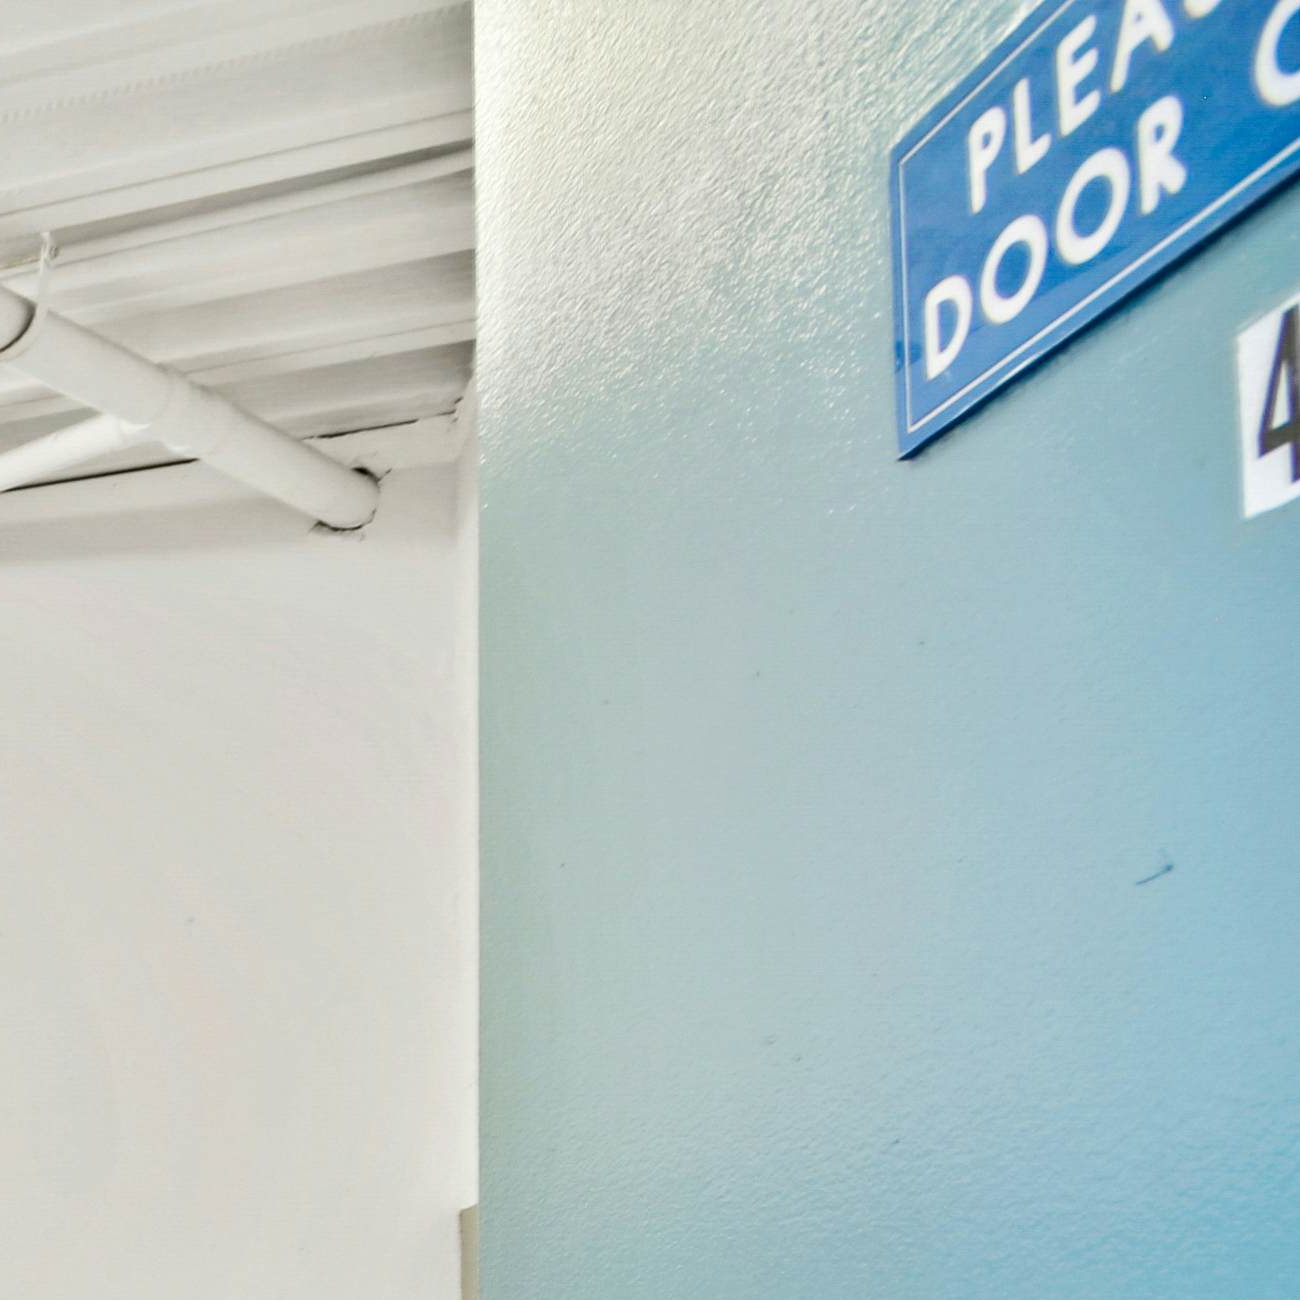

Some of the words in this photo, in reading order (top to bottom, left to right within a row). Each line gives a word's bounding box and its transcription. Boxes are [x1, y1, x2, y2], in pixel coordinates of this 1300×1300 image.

[966, 0, 1222, 215] PLEA
[923, 96, 1188, 381] DOOR
[1257, 306, 1300, 486] 4
